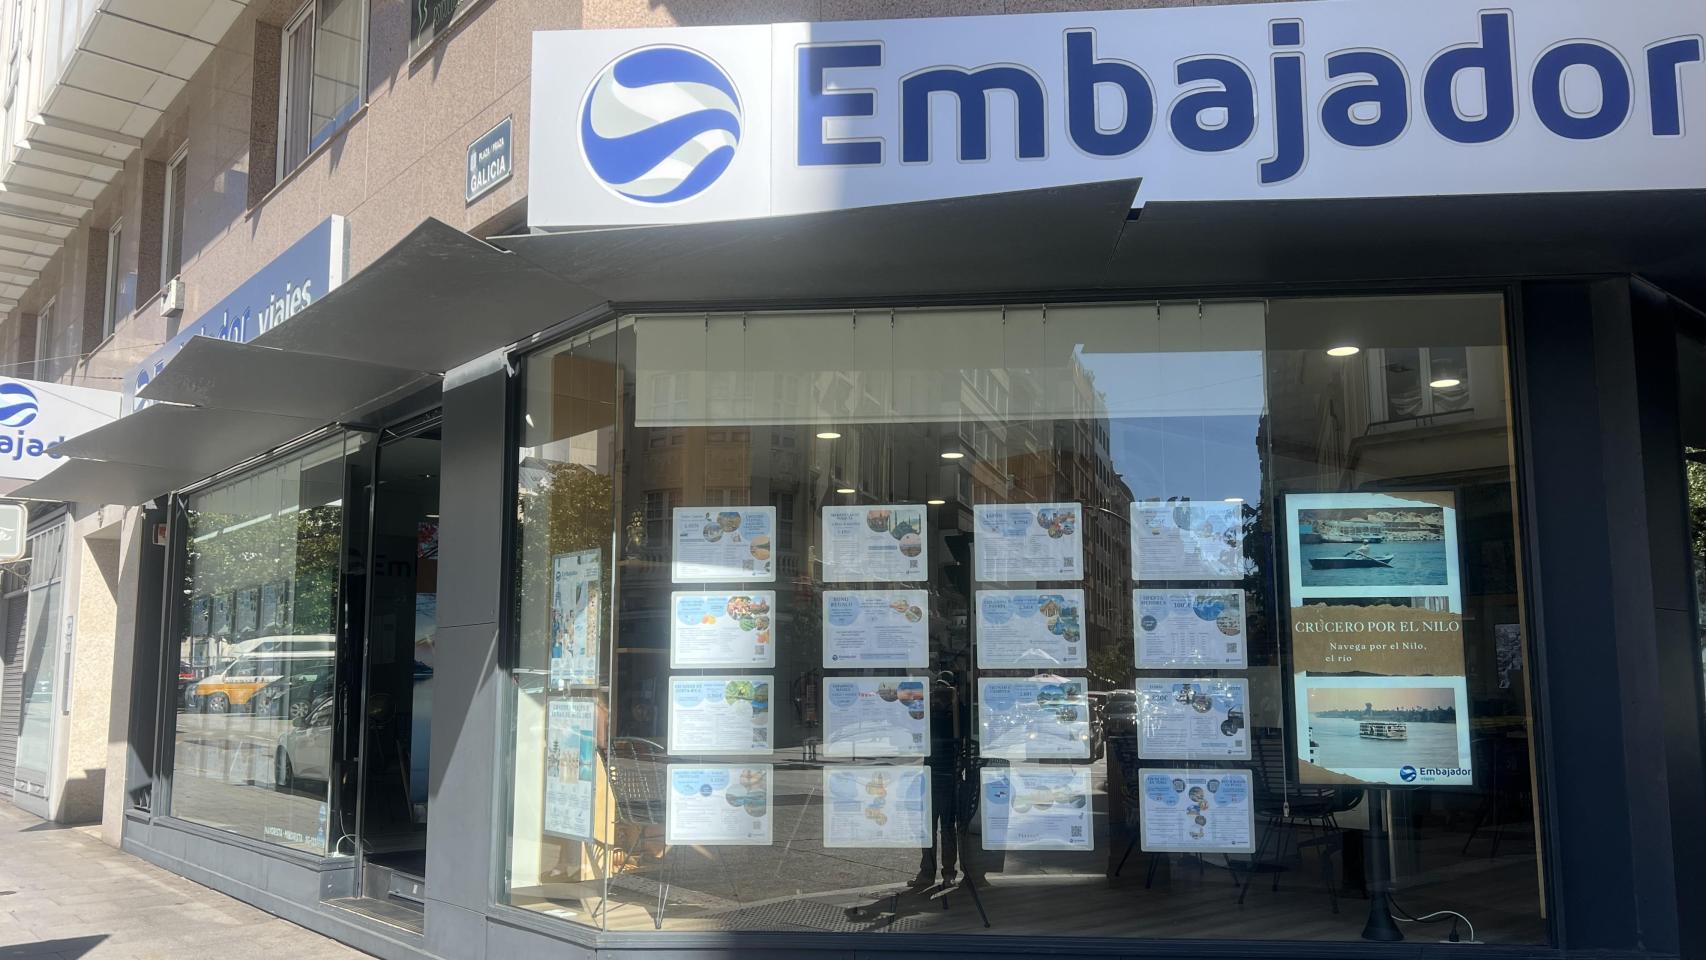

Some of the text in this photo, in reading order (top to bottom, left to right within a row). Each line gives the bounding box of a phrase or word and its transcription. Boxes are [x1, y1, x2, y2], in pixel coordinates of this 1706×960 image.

[797, 8, 1704, 185] Embajador
[470, 155, 506, 192] GALICIA
[1295, 620, 1459, 633] CRUCERO POR EL NILO
[1330, 642, 1427, 652] Navega por el Nilo,
[1325, 654, 1334, 662] el
[1420, 767, 1472, 777] Embajador
